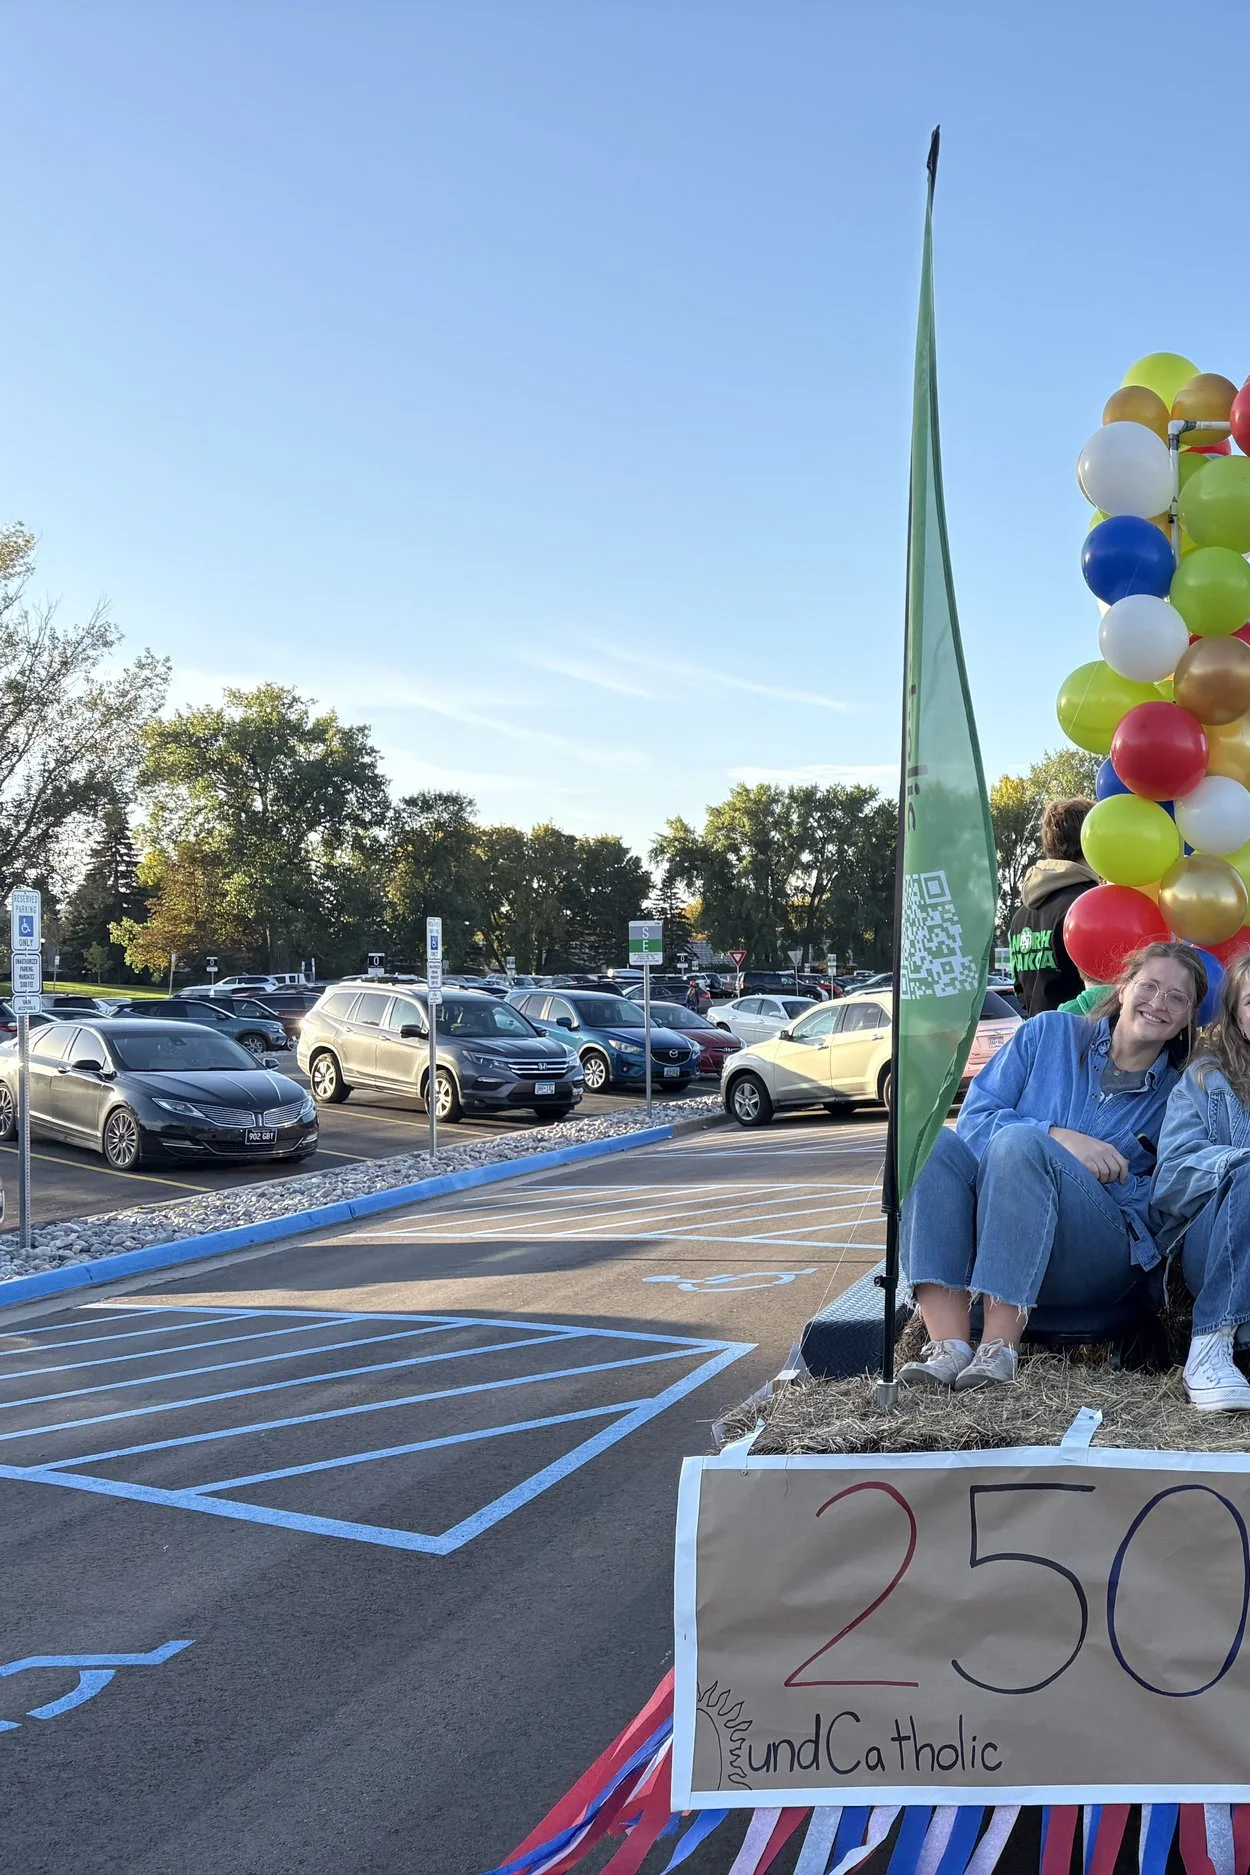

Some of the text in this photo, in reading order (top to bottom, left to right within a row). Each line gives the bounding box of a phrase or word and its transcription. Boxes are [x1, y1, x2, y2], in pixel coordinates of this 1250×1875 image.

[14, 894, 38, 904] RESERVED
[15, 905, 37, 914] PARKING
[642, 926, 649, 939] S
[19, 938, 34, 947] ONLY
[643, 940, 649, 952] E
[784, 1481, 1250, 1698] 250
